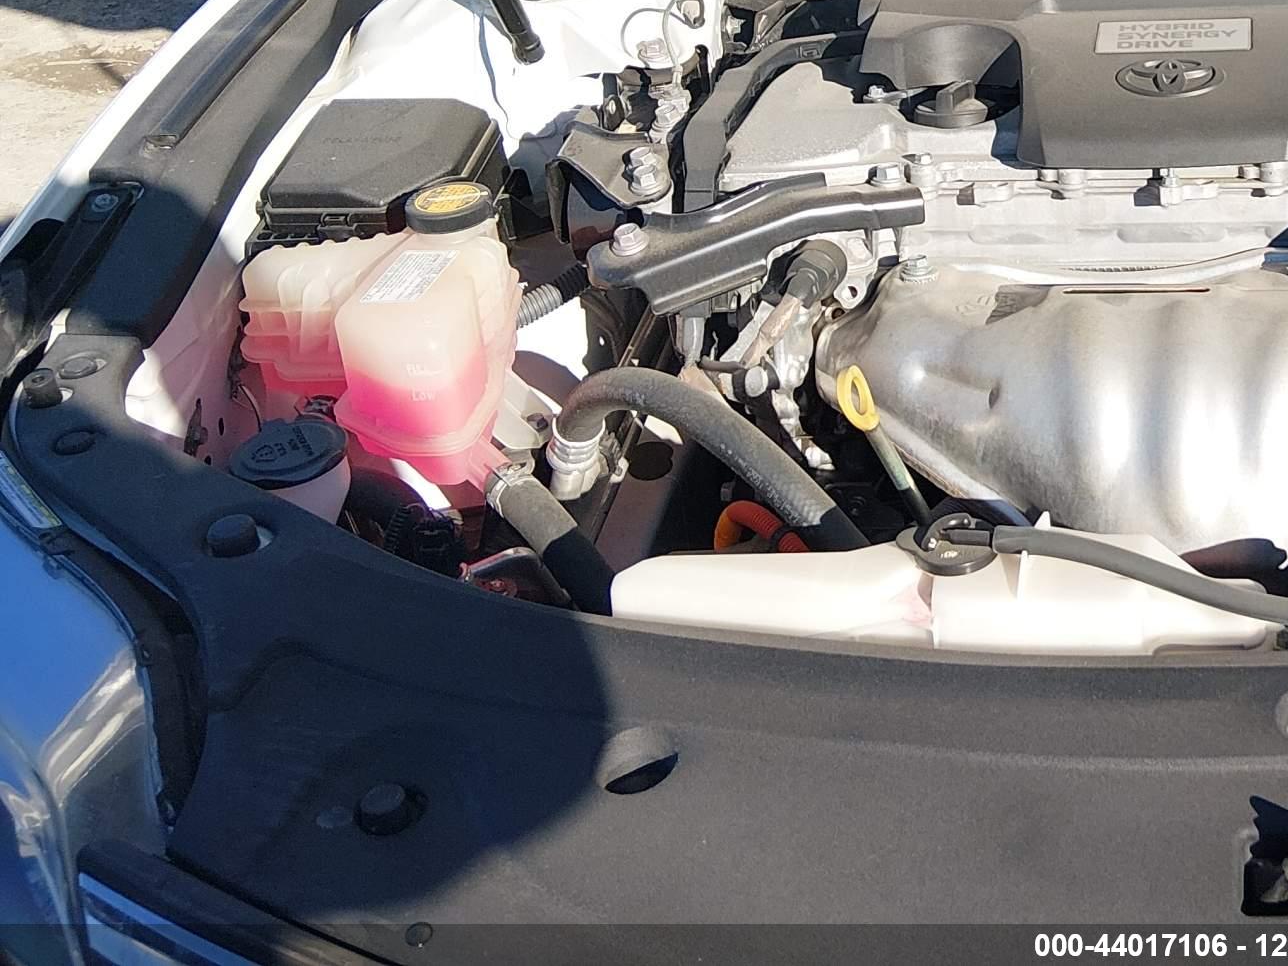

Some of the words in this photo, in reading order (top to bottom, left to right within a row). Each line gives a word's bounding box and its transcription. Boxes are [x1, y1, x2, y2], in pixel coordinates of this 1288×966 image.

[1119, 21, 1215, 32] HYBRID
[1117, 29, 1238, 41] SYNERGY
[1116, 40, 1193, 50] DRIVE
